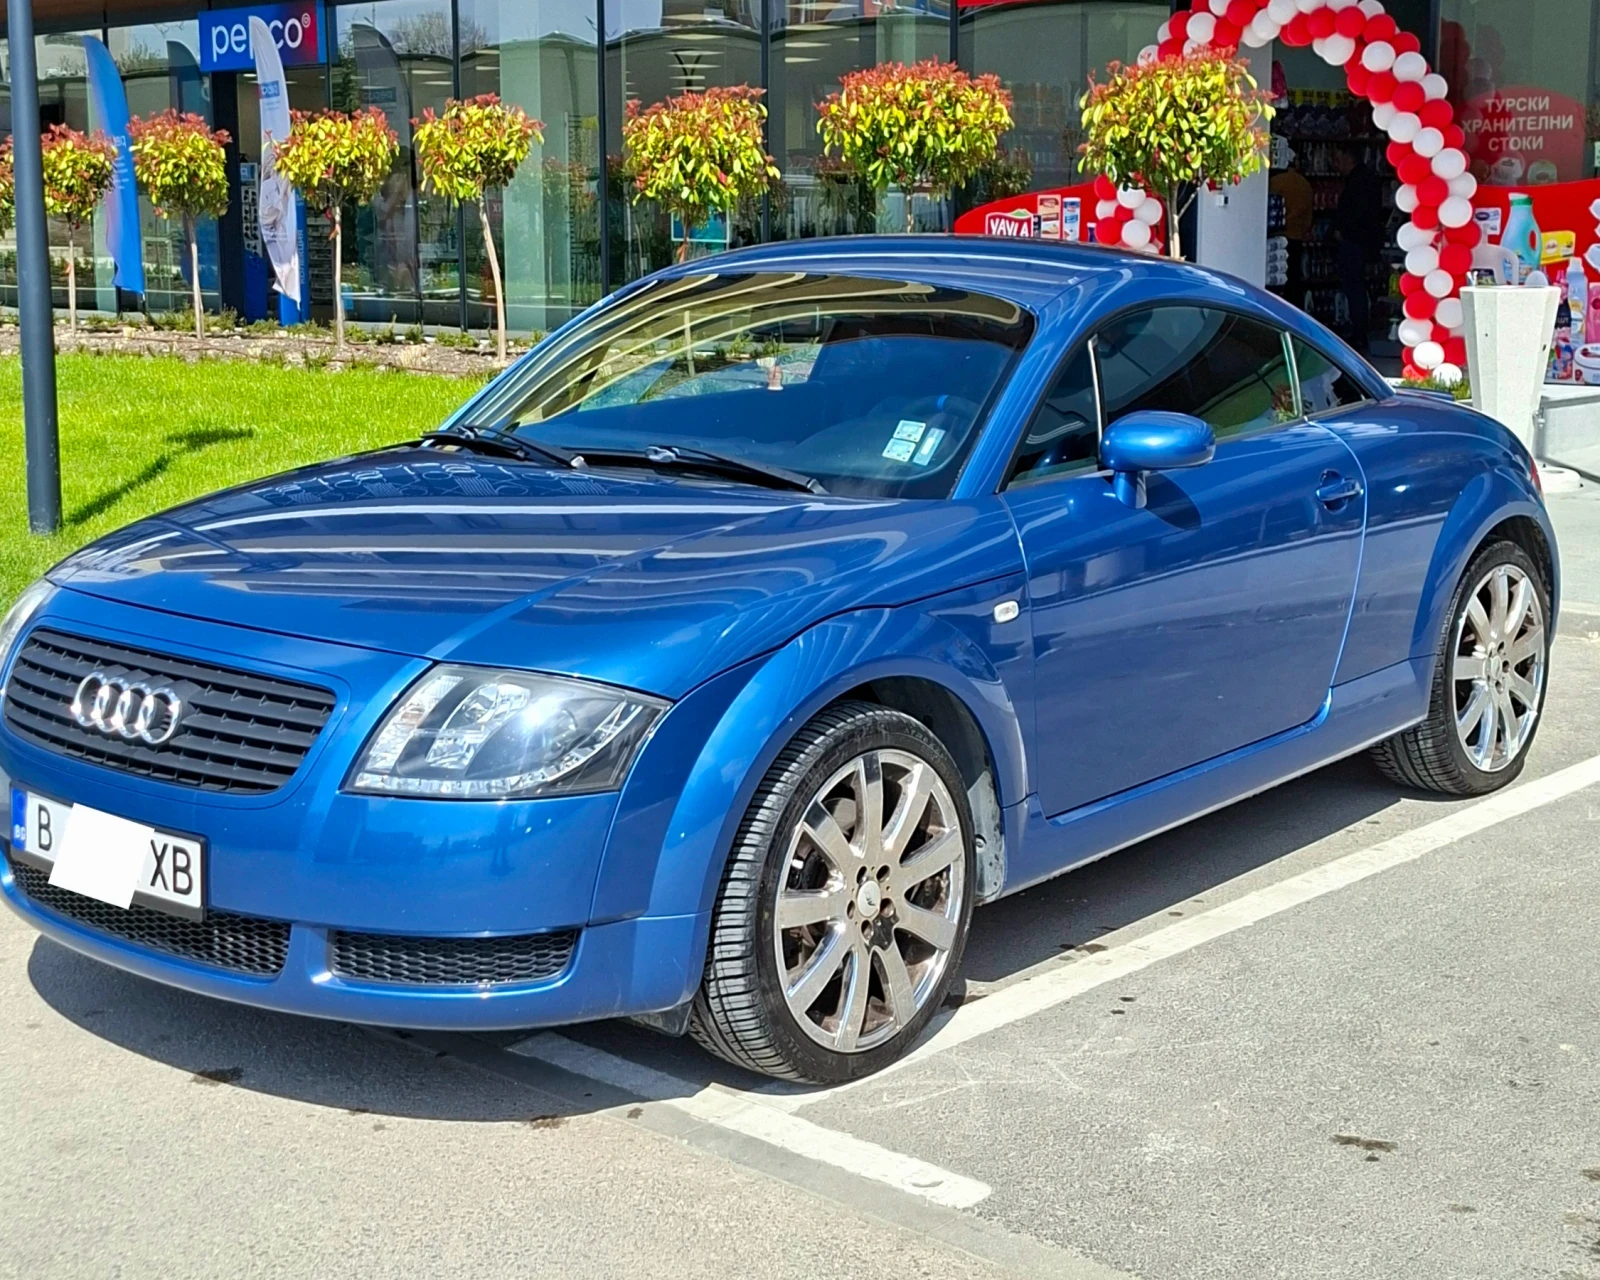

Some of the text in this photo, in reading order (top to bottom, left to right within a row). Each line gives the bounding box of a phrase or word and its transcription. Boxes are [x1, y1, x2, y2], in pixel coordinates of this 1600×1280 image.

[1485, 96, 1550, 113] ТУРСКИ
[1462, 115, 1574, 133] ХРАНИТЕЛНИ
[1488, 136, 1544, 151] СТОКИ
[14, 824, 26, 841] BG
[38, 804, 193, 895] B XB
